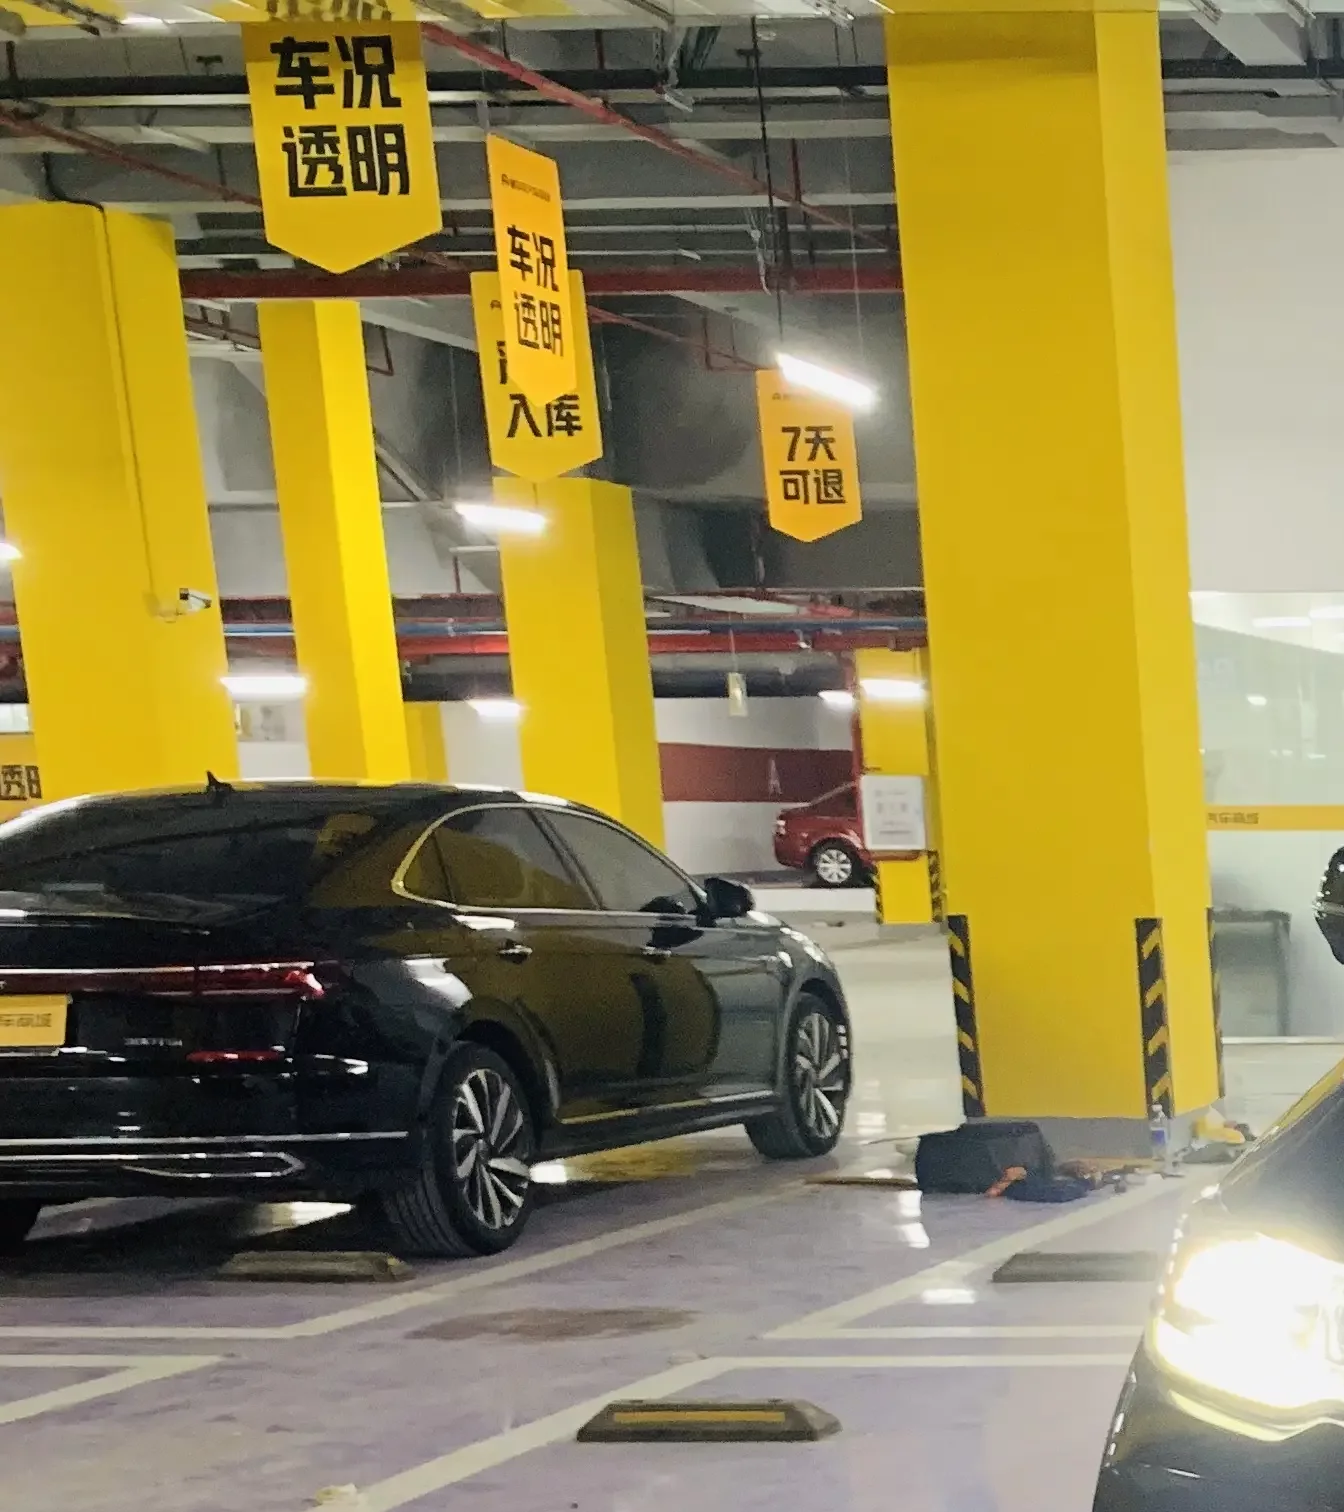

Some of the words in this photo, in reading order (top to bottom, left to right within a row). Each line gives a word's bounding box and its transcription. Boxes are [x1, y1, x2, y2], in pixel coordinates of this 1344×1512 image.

[270, 35, 402, 109] 车况
[282, 124, 410, 197] 透明
[507, 224, 559, 292] 车况
[513, 290, 563, 356] 透明
[506, 393, 583, 438] 入库
[781, 425, 837, 462] 7天
[779, 468, 847, 504] 可退
